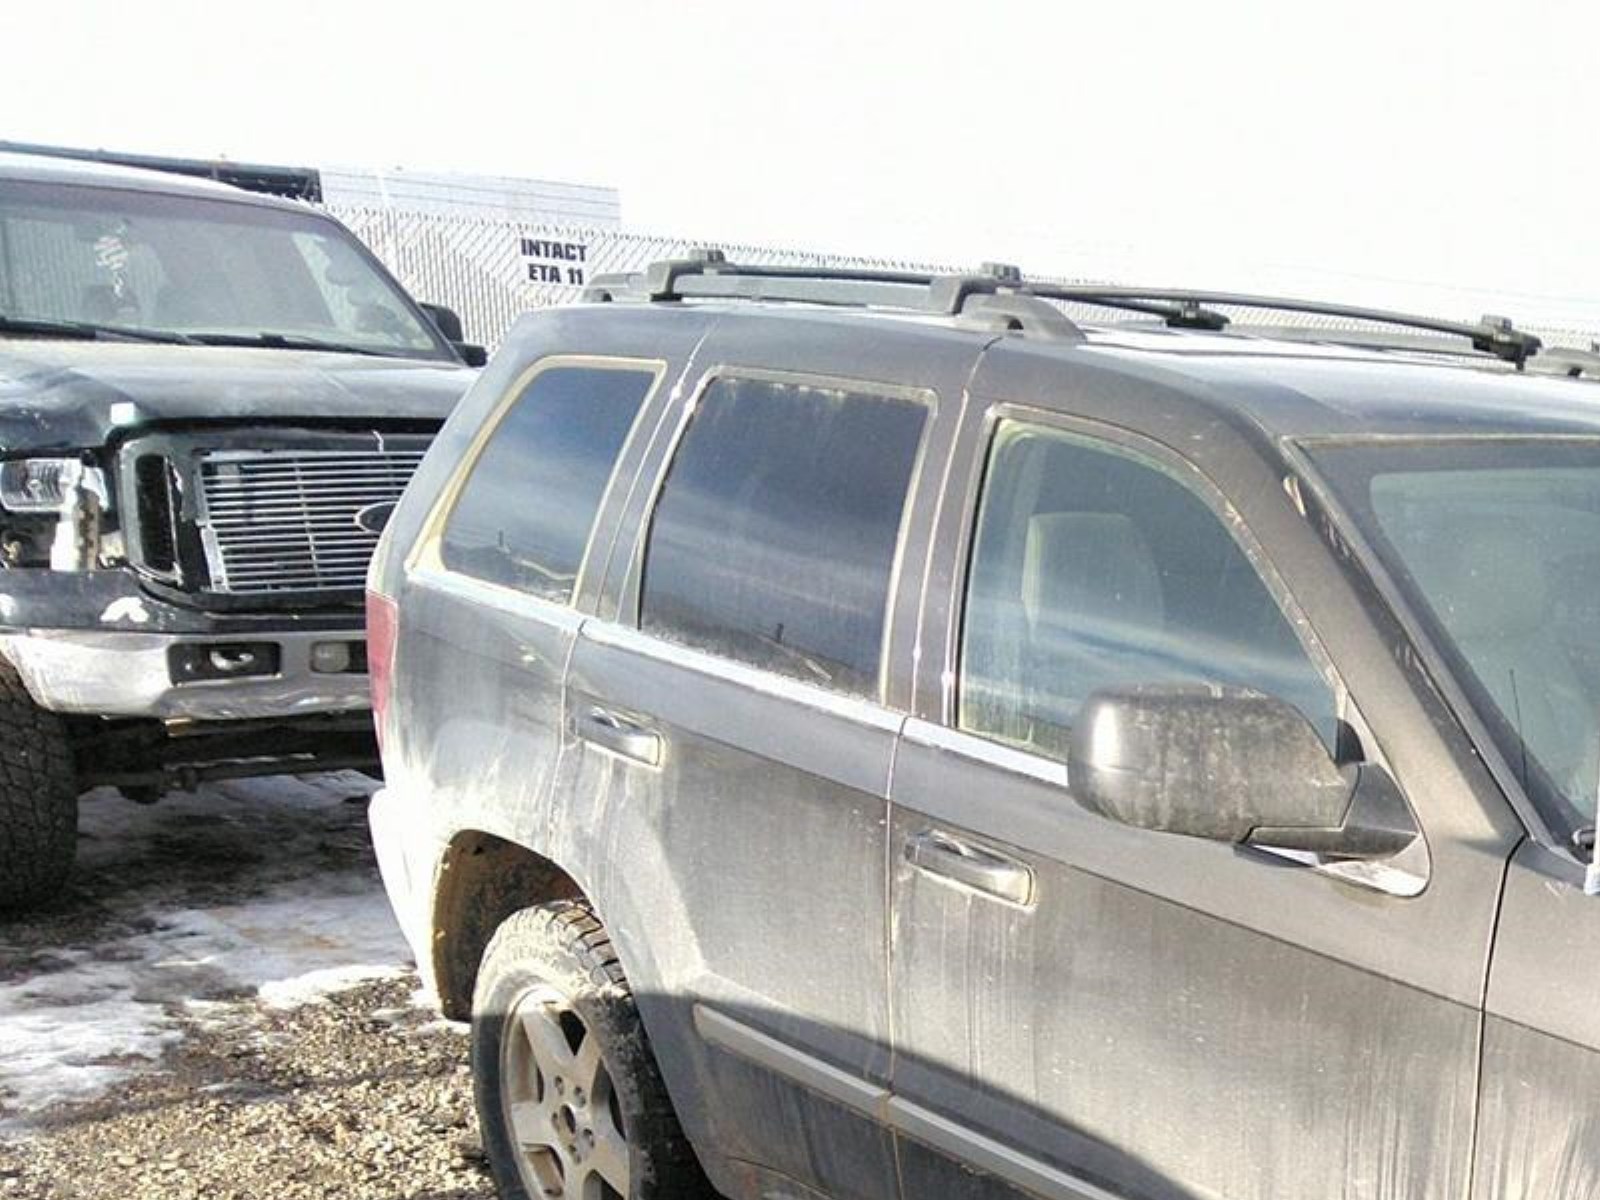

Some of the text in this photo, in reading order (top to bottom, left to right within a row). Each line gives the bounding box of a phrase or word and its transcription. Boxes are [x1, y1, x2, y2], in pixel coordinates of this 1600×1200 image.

[521, 238, 588, 262] INTACT
[528, 263, 584, 286] ETA 11
